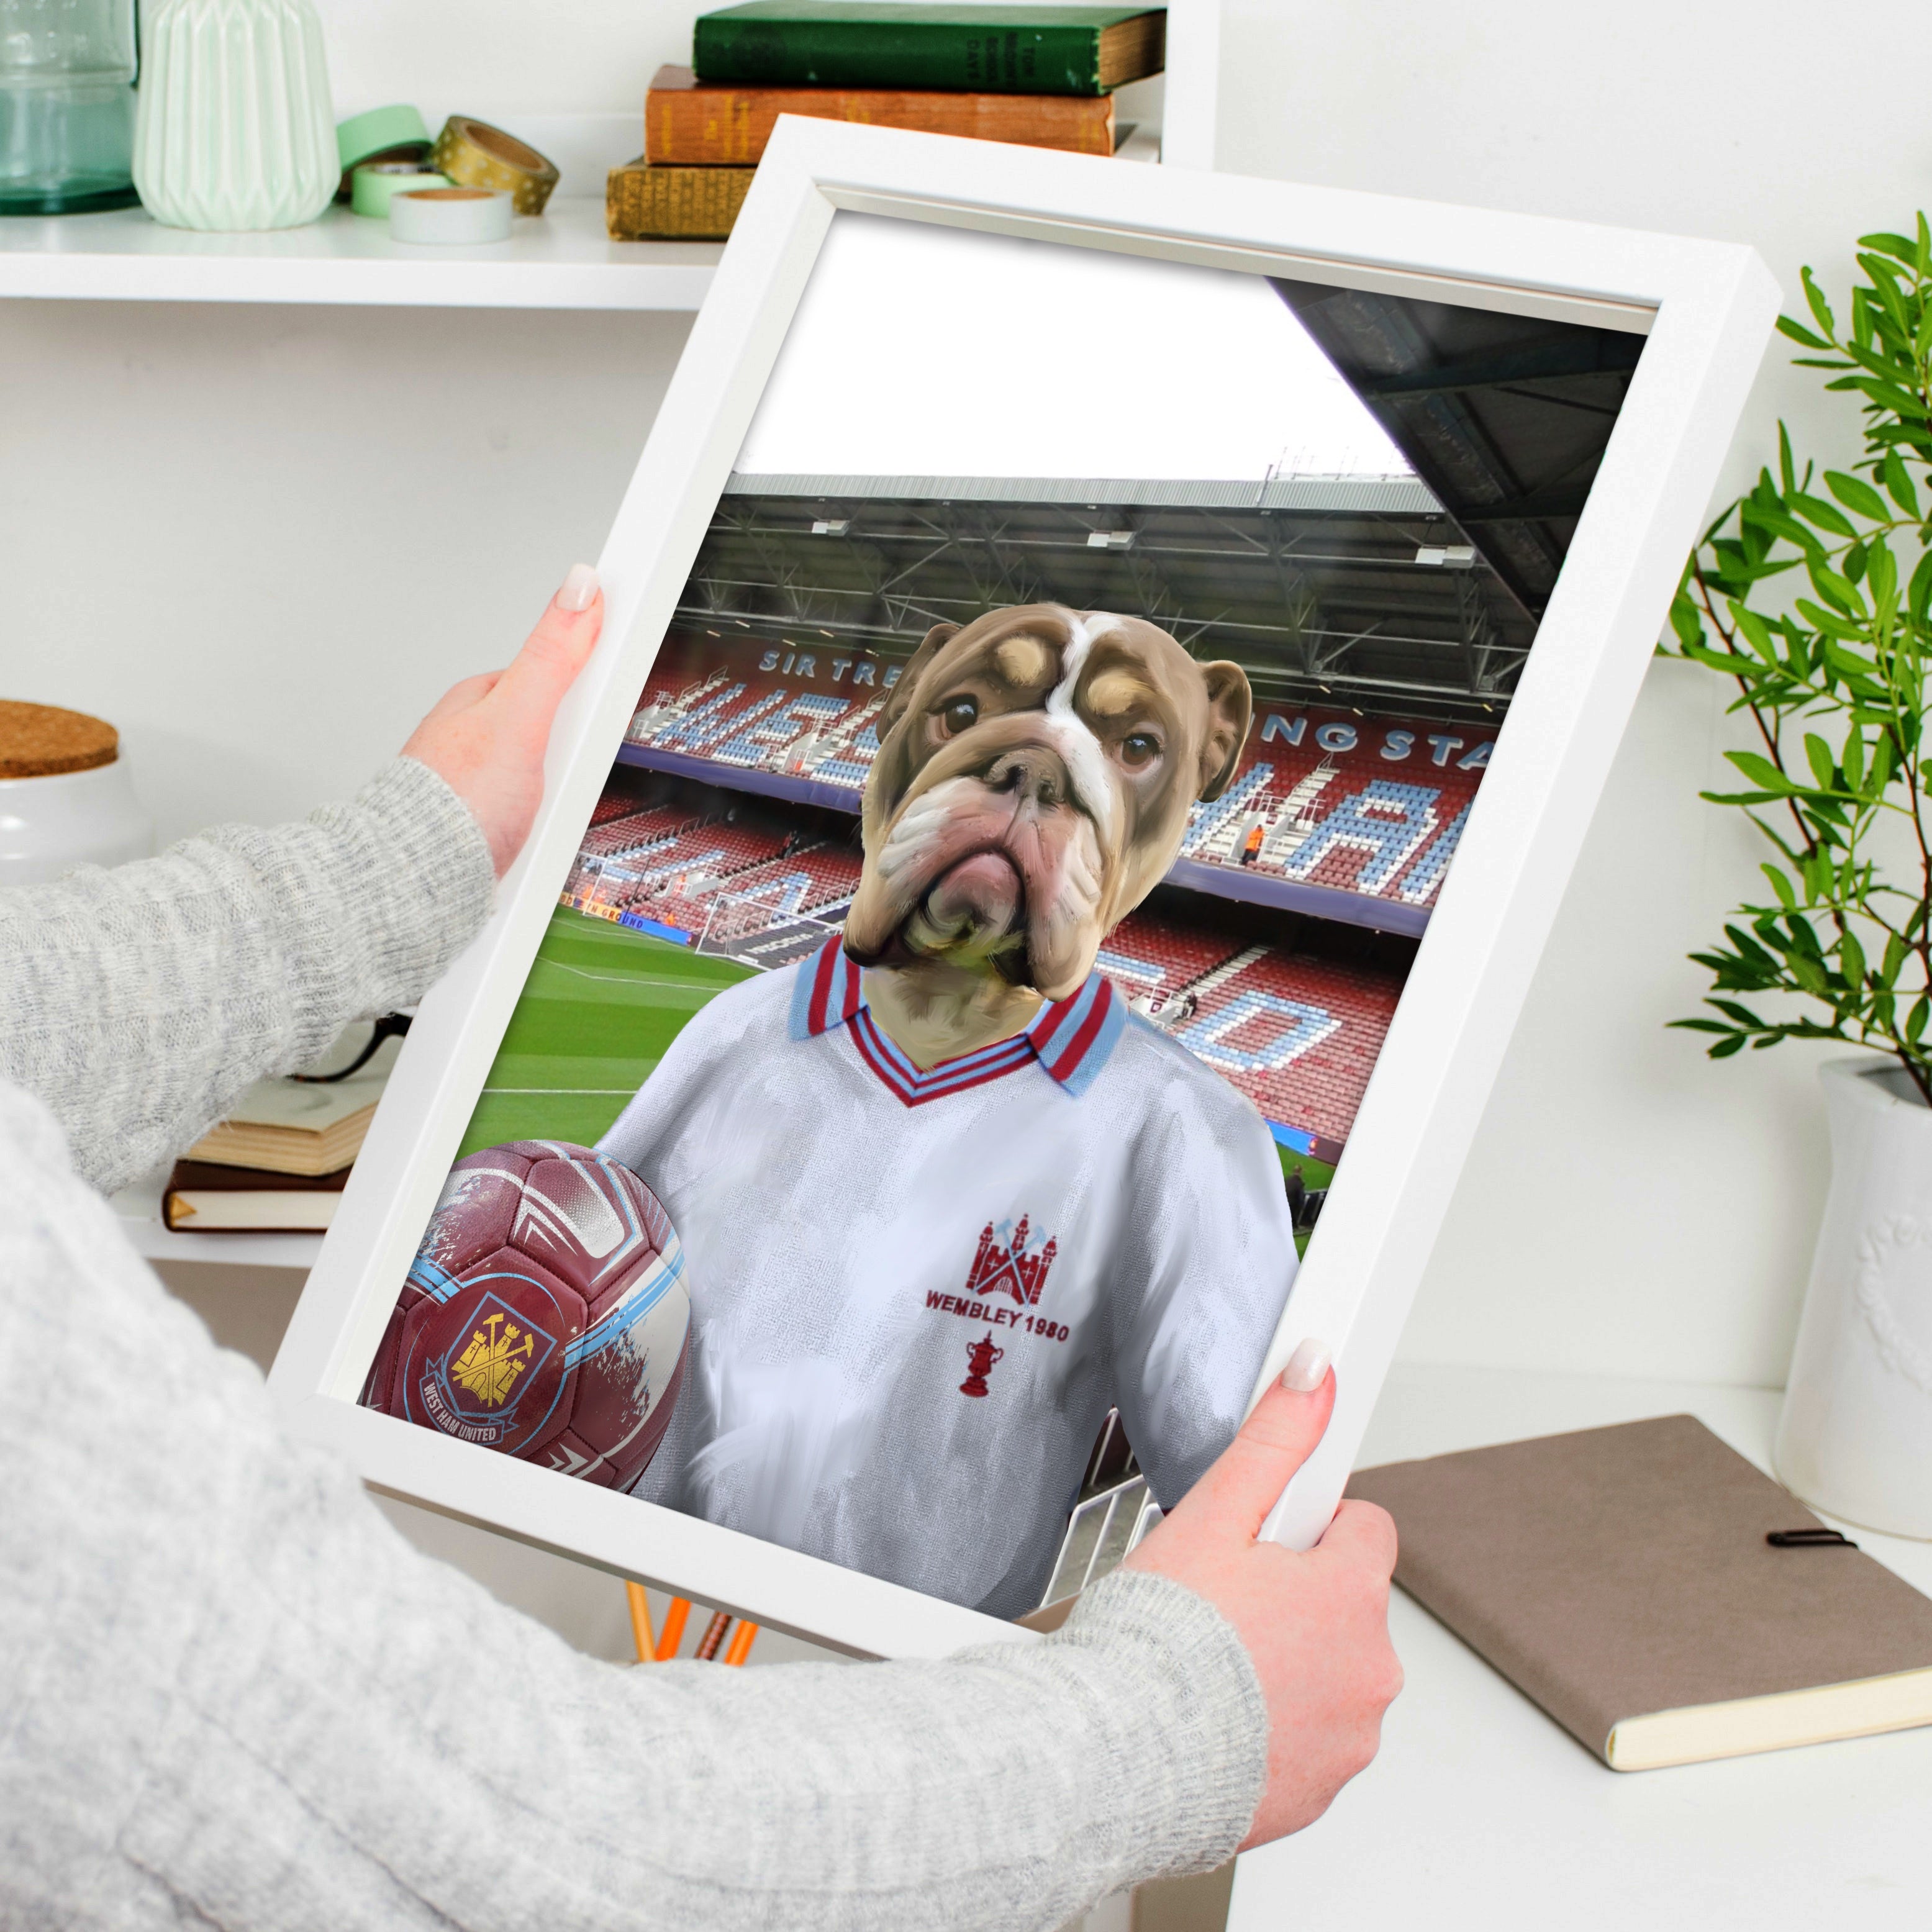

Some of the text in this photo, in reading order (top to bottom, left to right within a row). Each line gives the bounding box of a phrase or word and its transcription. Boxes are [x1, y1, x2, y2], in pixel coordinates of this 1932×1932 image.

[759, 650, 815, 678] SIR
[602, 909, 643, 929] GROUND
[925, 1289, 1070, 1342] WEMBLEY 1980
[424, 1382, 496, 1441] WEST HAM UNITED
